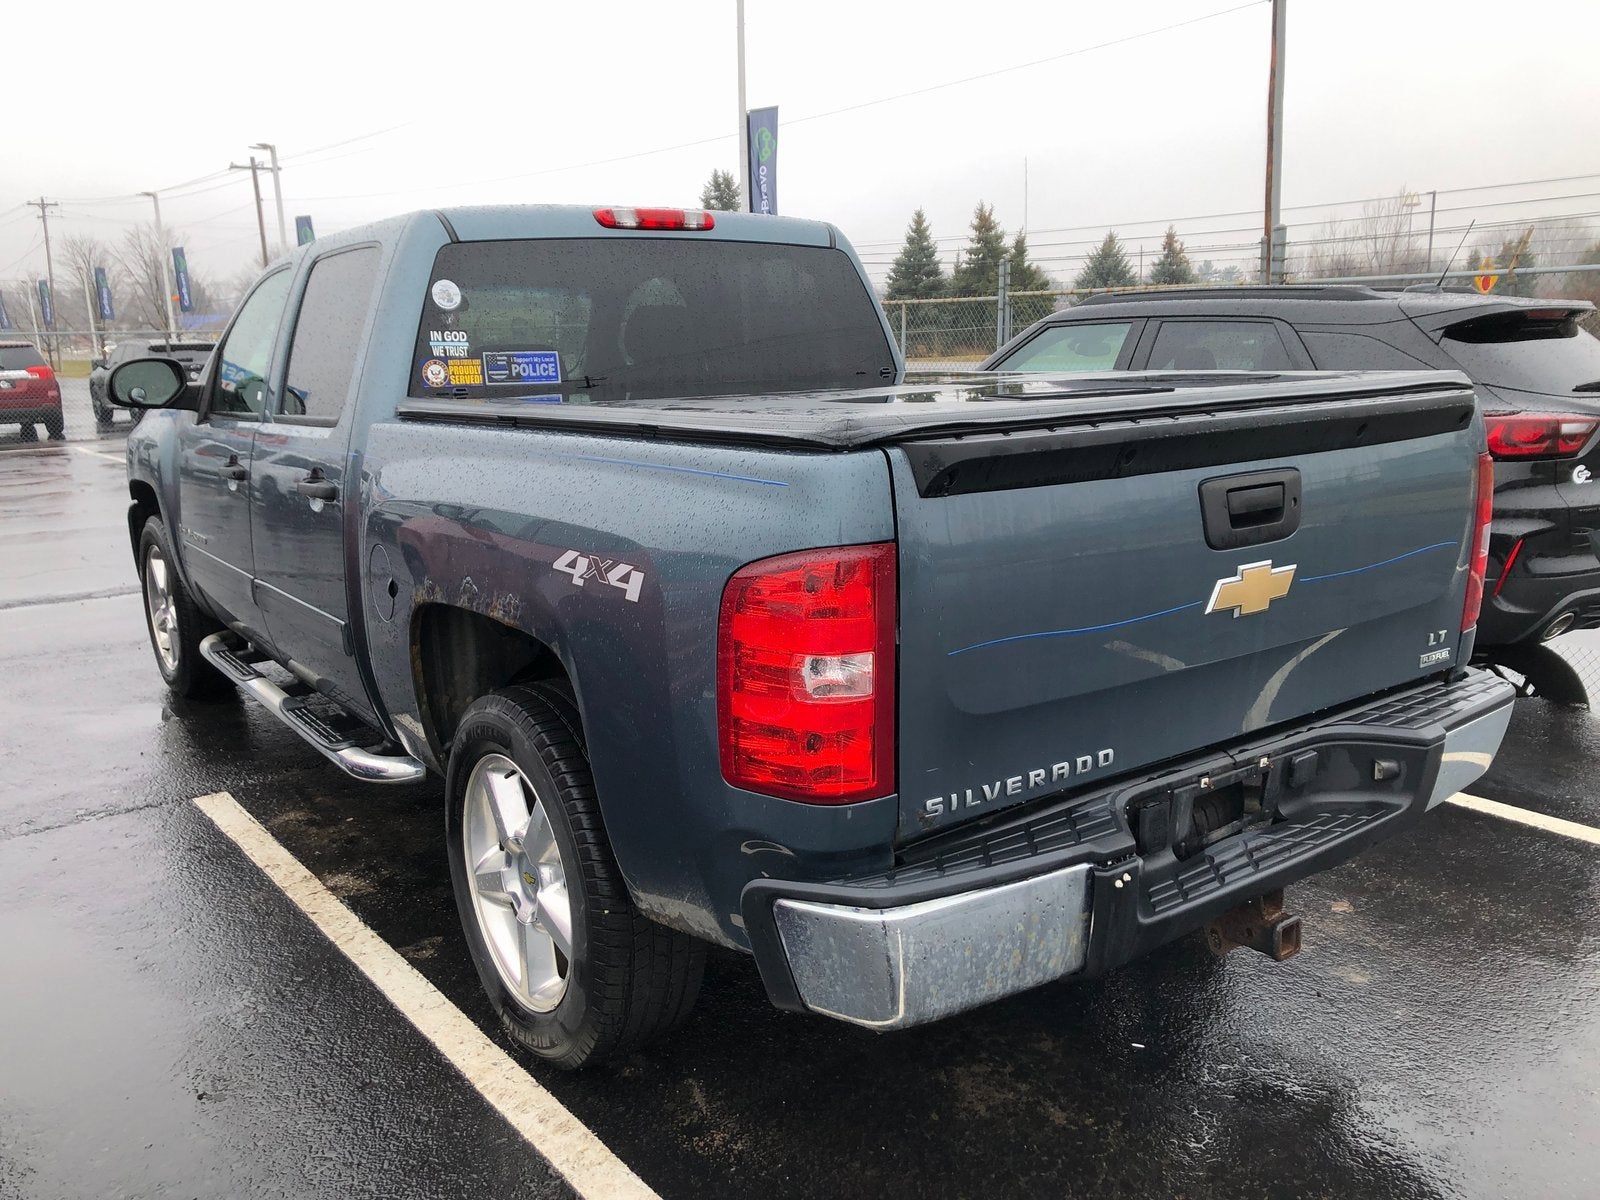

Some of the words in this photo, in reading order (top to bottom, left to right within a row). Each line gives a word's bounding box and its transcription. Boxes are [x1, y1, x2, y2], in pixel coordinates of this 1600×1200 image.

[430, 331, 442, 341] IN
[444, 331, 467, 341] GOD
[432, 346, 445, 357] WE
[445, 346, 468, 357] TRUST
[449, 365, 481, 375] PROUDLY
[511, 363, 556, 377] POLICE
[450, 374, 483, 385] SERVED!
[1428, 629, 1447, 647] LT
[925, 749, 1115, 818] SILVERADO
